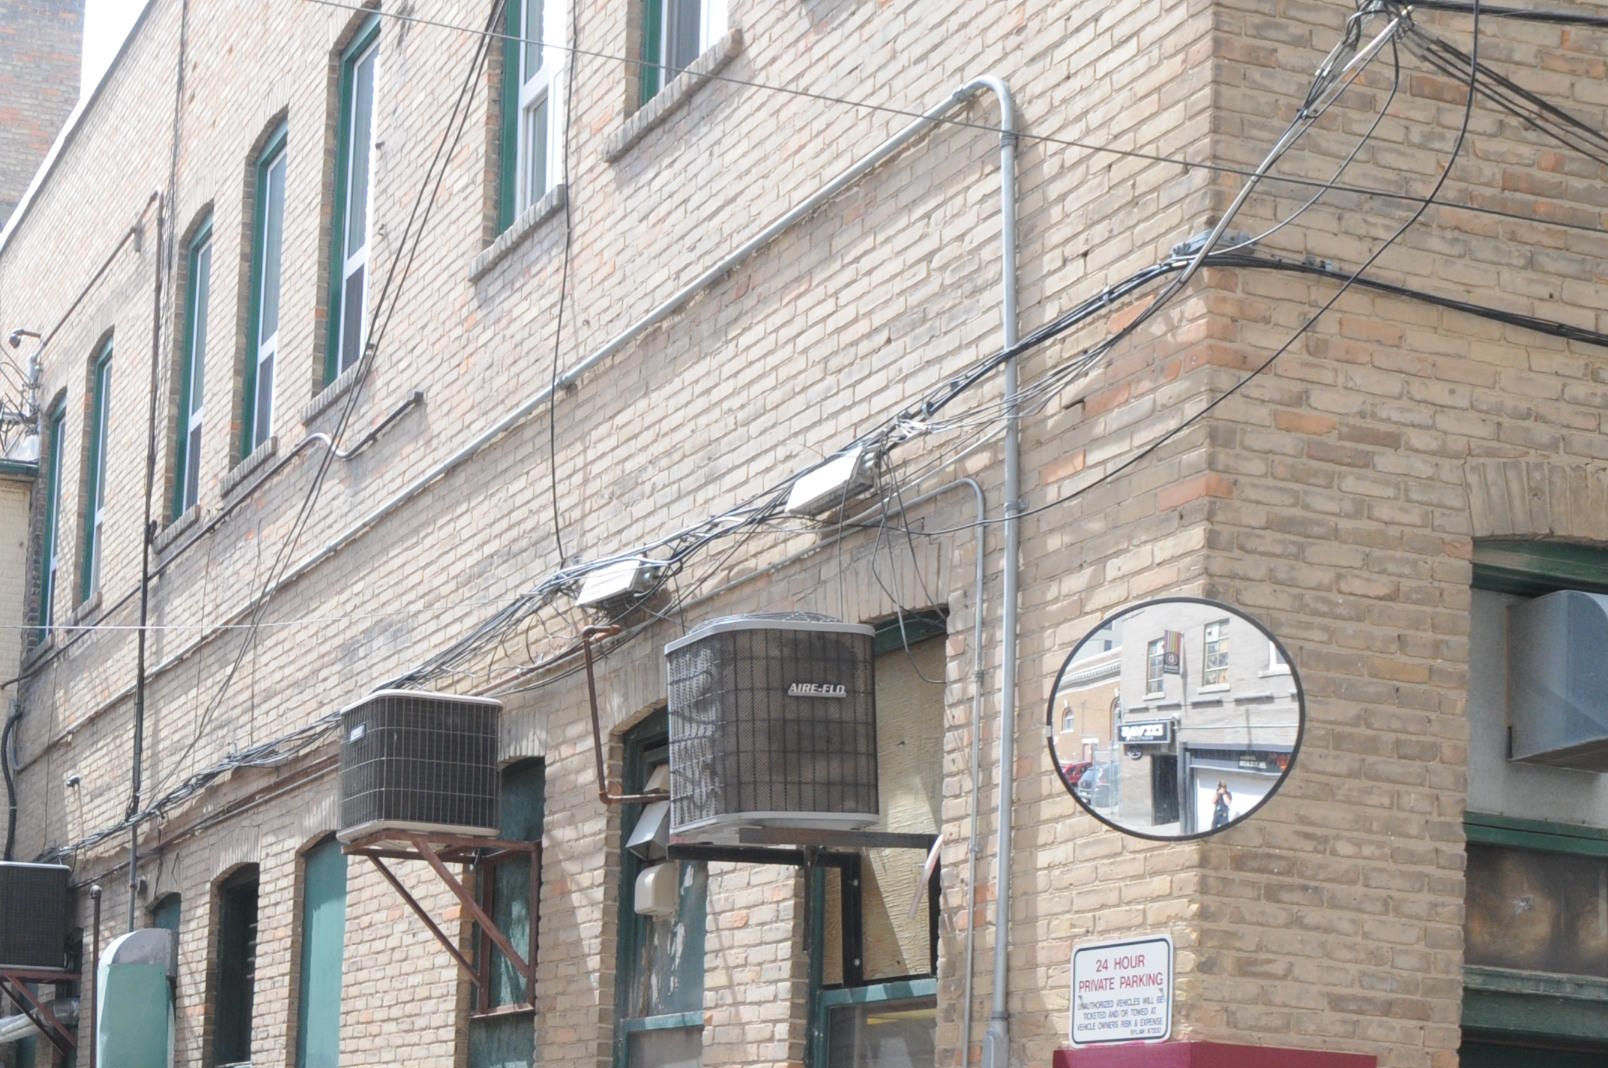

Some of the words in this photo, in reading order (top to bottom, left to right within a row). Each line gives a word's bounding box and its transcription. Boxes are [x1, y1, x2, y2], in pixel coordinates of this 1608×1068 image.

[789, 682, 846, 694] AIRE-FLO
[1095, 958, 1109, 973] 24
[1113, 954, 1145, 970] HOUR
[1078, 976, 1115, 993] PRIVATE
[1119, 971, 1163, 990] PARKING
[1116, 997, 1141, 1007] VEHICLES
[1130, 1007, 1149, 1016] TOWED
[1077, 1022, 1096, 1032] VEHICLE
